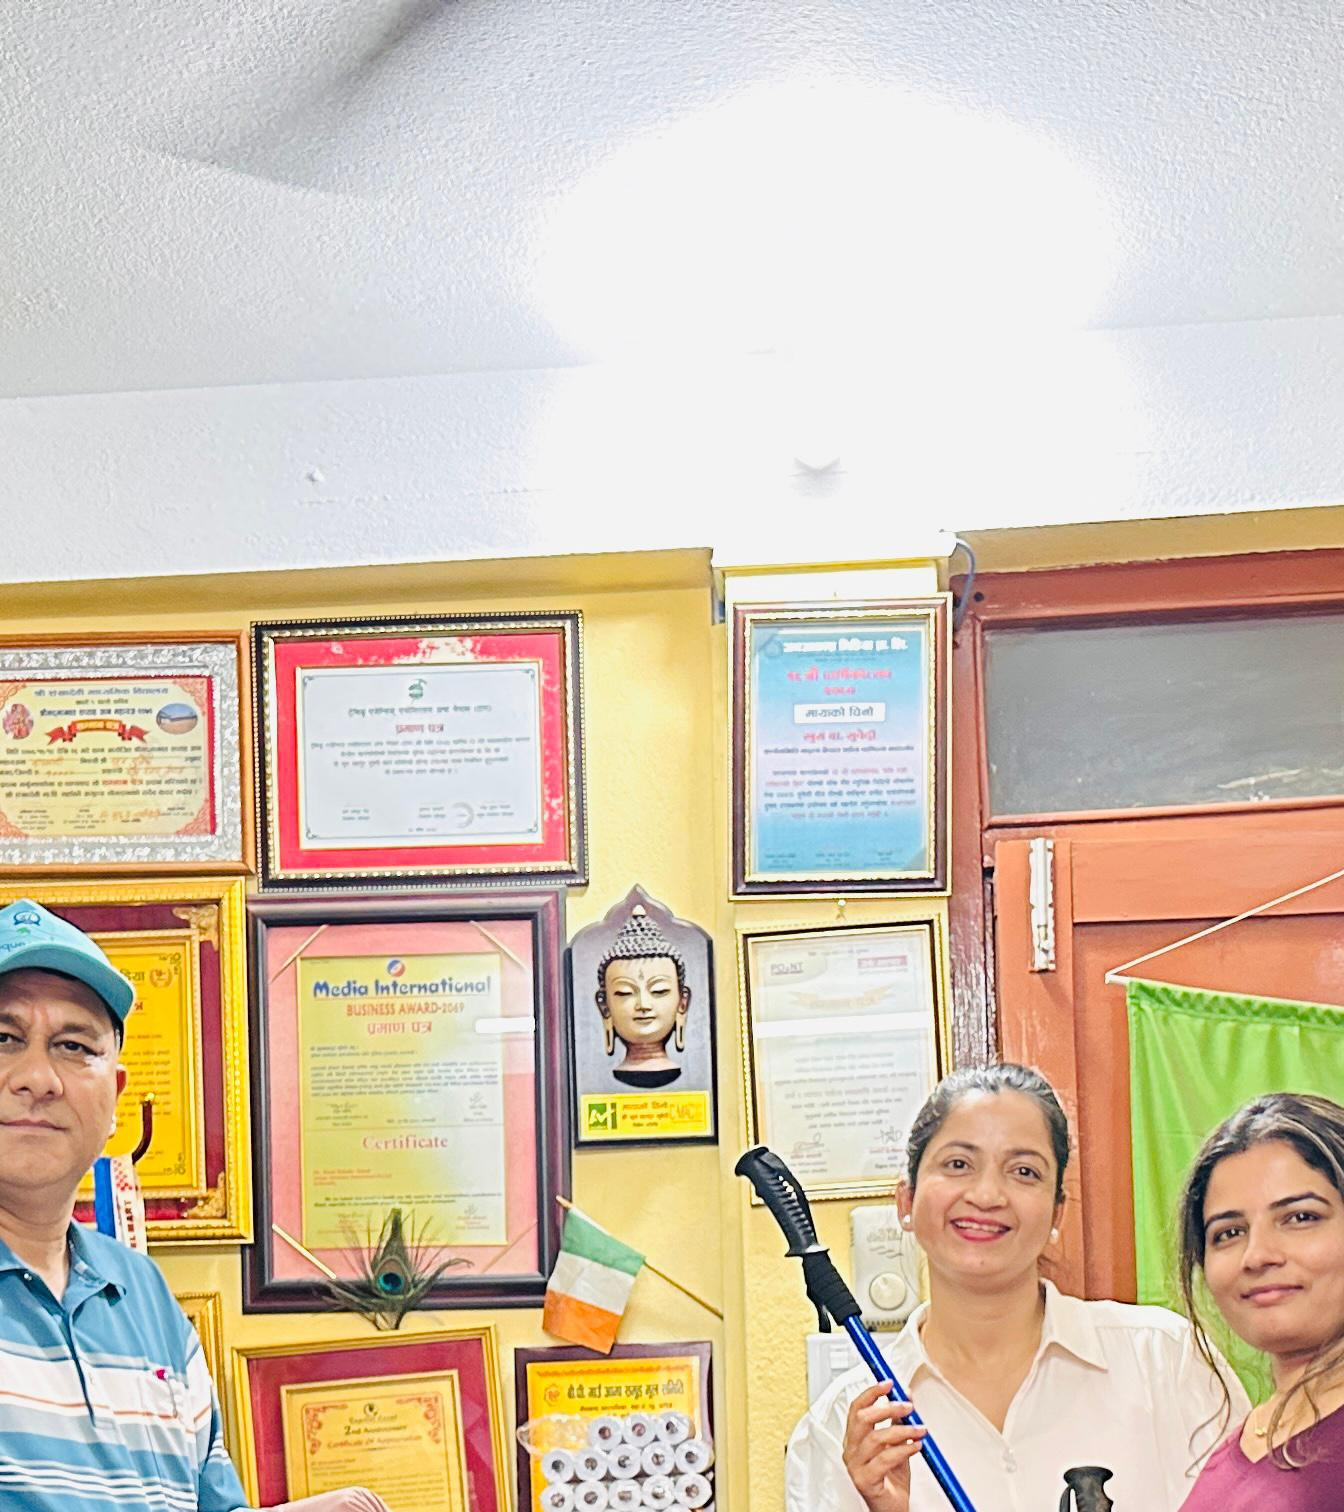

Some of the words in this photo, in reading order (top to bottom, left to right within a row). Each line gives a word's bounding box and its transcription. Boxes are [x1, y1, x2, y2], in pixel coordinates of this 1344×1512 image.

[312, 980, 369, 999] Media
[374, 976, 492, 997] International
[345, 1002, 397, 1017] BUSINESS
[362, 1134, 450, 1151] Certificate
